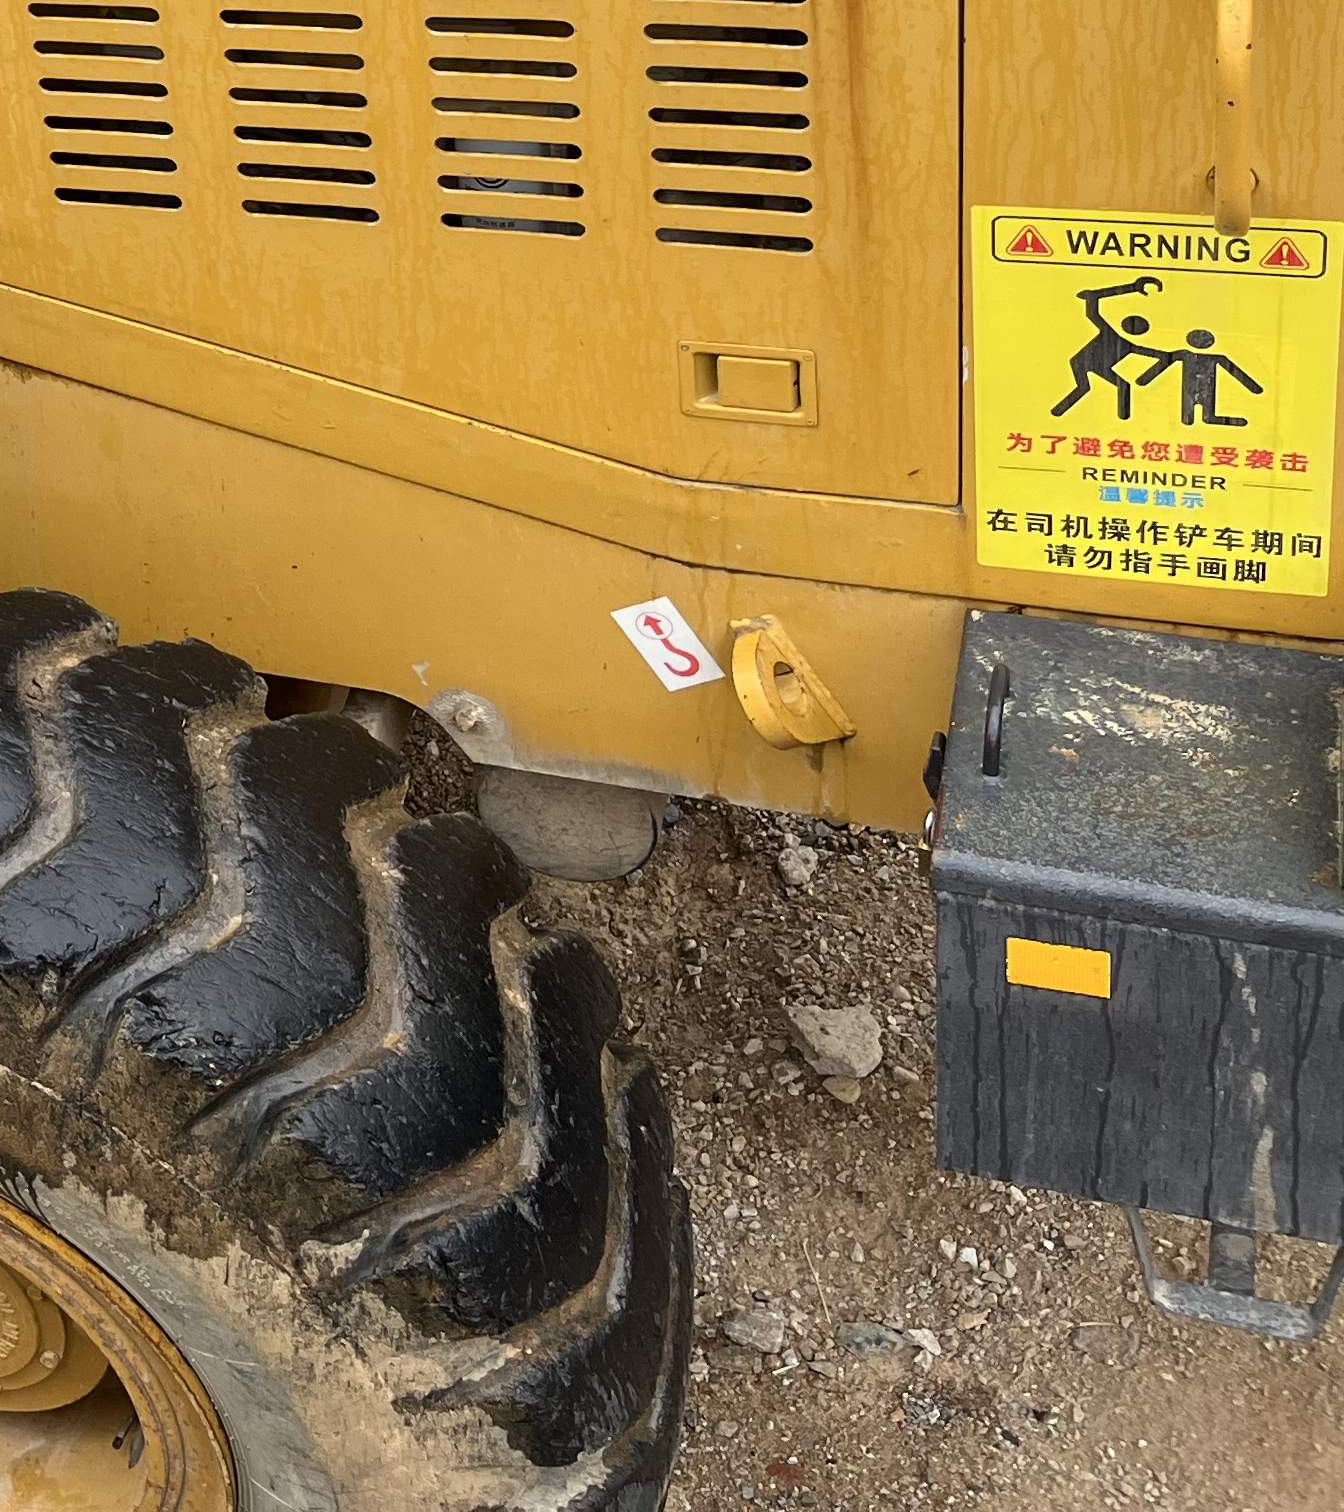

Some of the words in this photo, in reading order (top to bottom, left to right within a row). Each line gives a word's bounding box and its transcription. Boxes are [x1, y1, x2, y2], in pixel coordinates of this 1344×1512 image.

[1065, 229, 1251, 263] WARNING
[1006, 432, 1310, 473] 为了避免您遭受袭击
[1082, 467, 1227, 490] REMINDER
[1098, 485, 1205, 509] 温馨提示
[986, 508, 1322, 559] 在司机操作铲车期间
[1044, 543, 1267, 584] 请勿指手画脚
